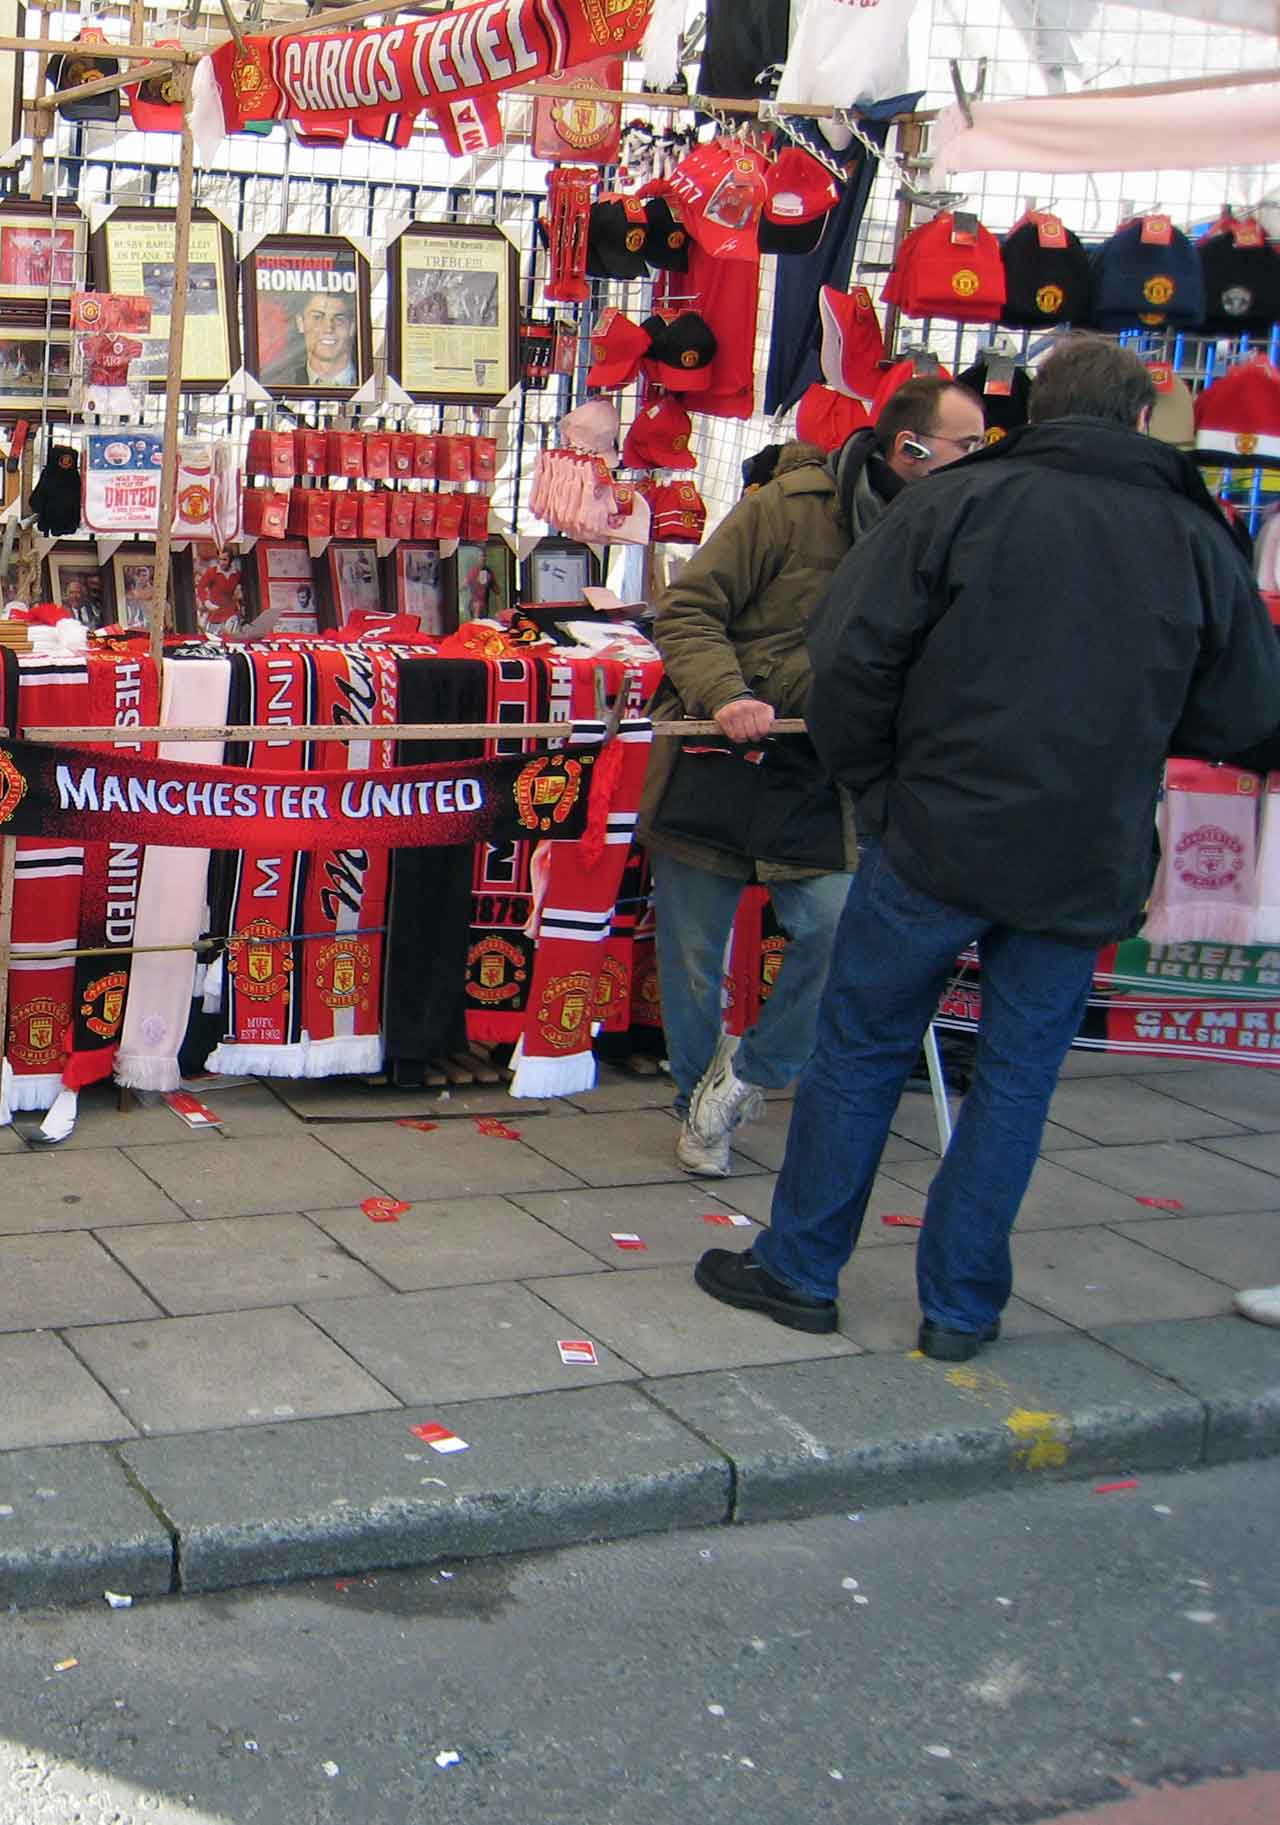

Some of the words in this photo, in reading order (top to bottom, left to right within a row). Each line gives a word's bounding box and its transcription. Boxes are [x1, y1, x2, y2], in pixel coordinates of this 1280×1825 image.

[283, 29, 406, 112] CARLOS
[256, 269, 357, 292] RONALDO
[104, 485, 157, 509] UNITED
[55, 764, 330, 820] MANCHESTER
[340, 777, 484, 818] UNITED
[1146, 960, 1245, 983] IRISH
[242, 981, 279, 994] UNITED
[240, 1028, 259, 1040] EST
[247, 1017, 273, 1028] MUFC
[1134, 1024, 1227, 1045] WELSH
